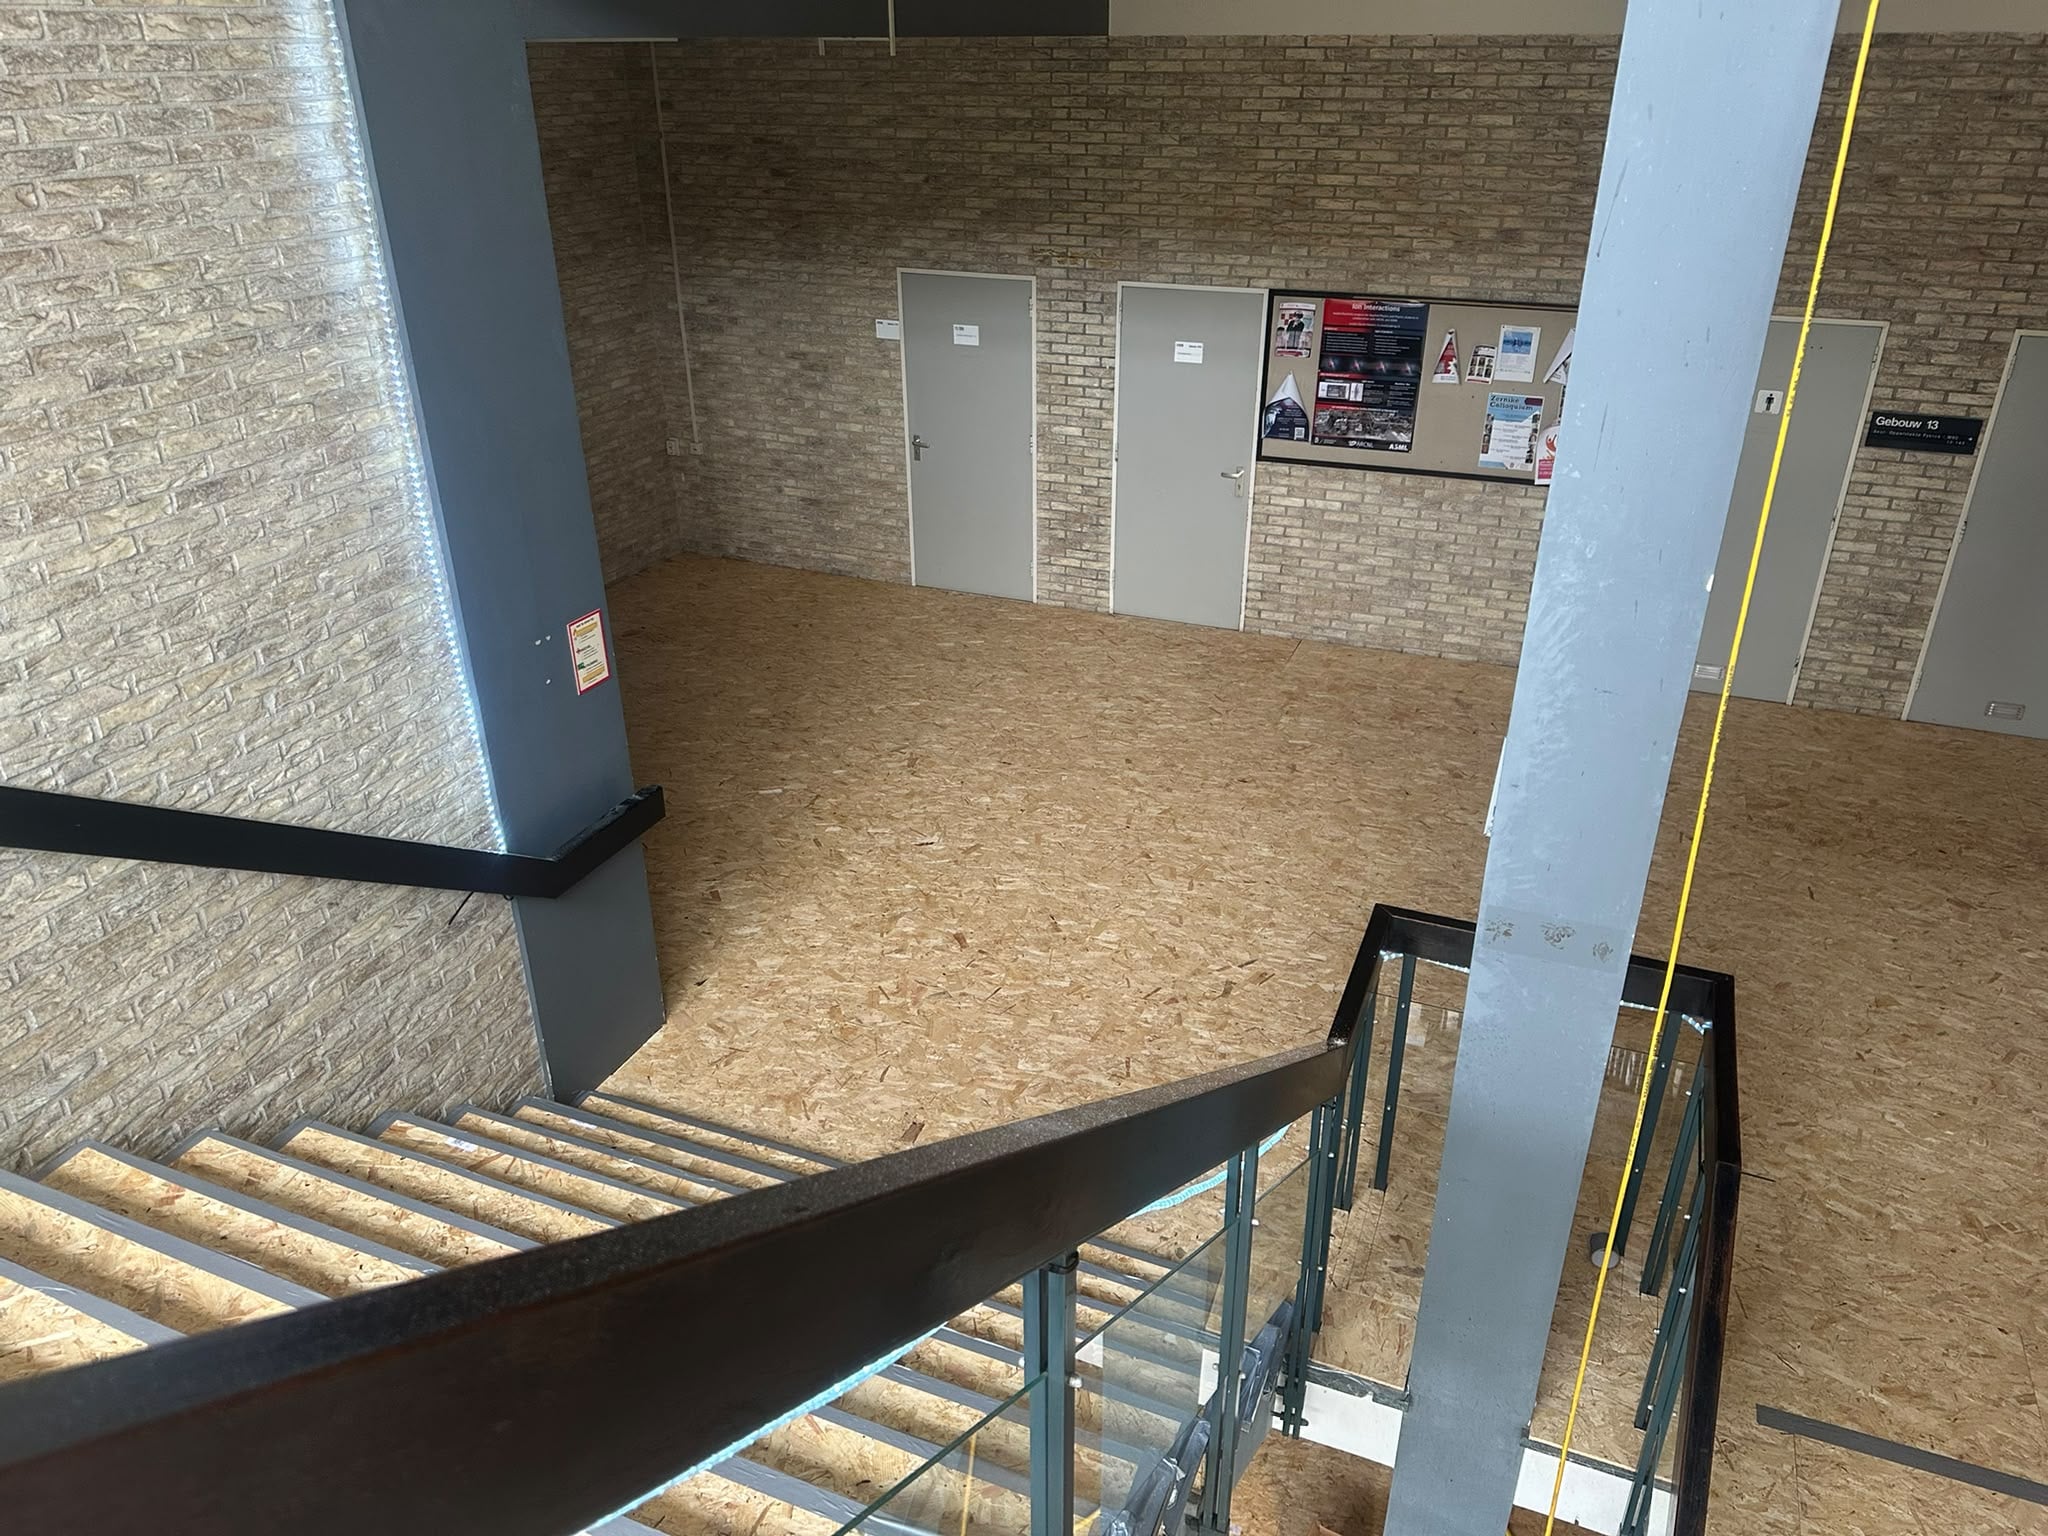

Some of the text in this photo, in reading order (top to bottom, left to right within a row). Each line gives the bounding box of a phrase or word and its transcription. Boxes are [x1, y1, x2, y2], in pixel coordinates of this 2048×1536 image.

[1363, 304, 1400, 312] Interactions
[1489, 401, 1533, 411] Colloquium
[1875, 416, 1939, 430] Gebouw 13
[1389, 443, 1408, 452] ASML
